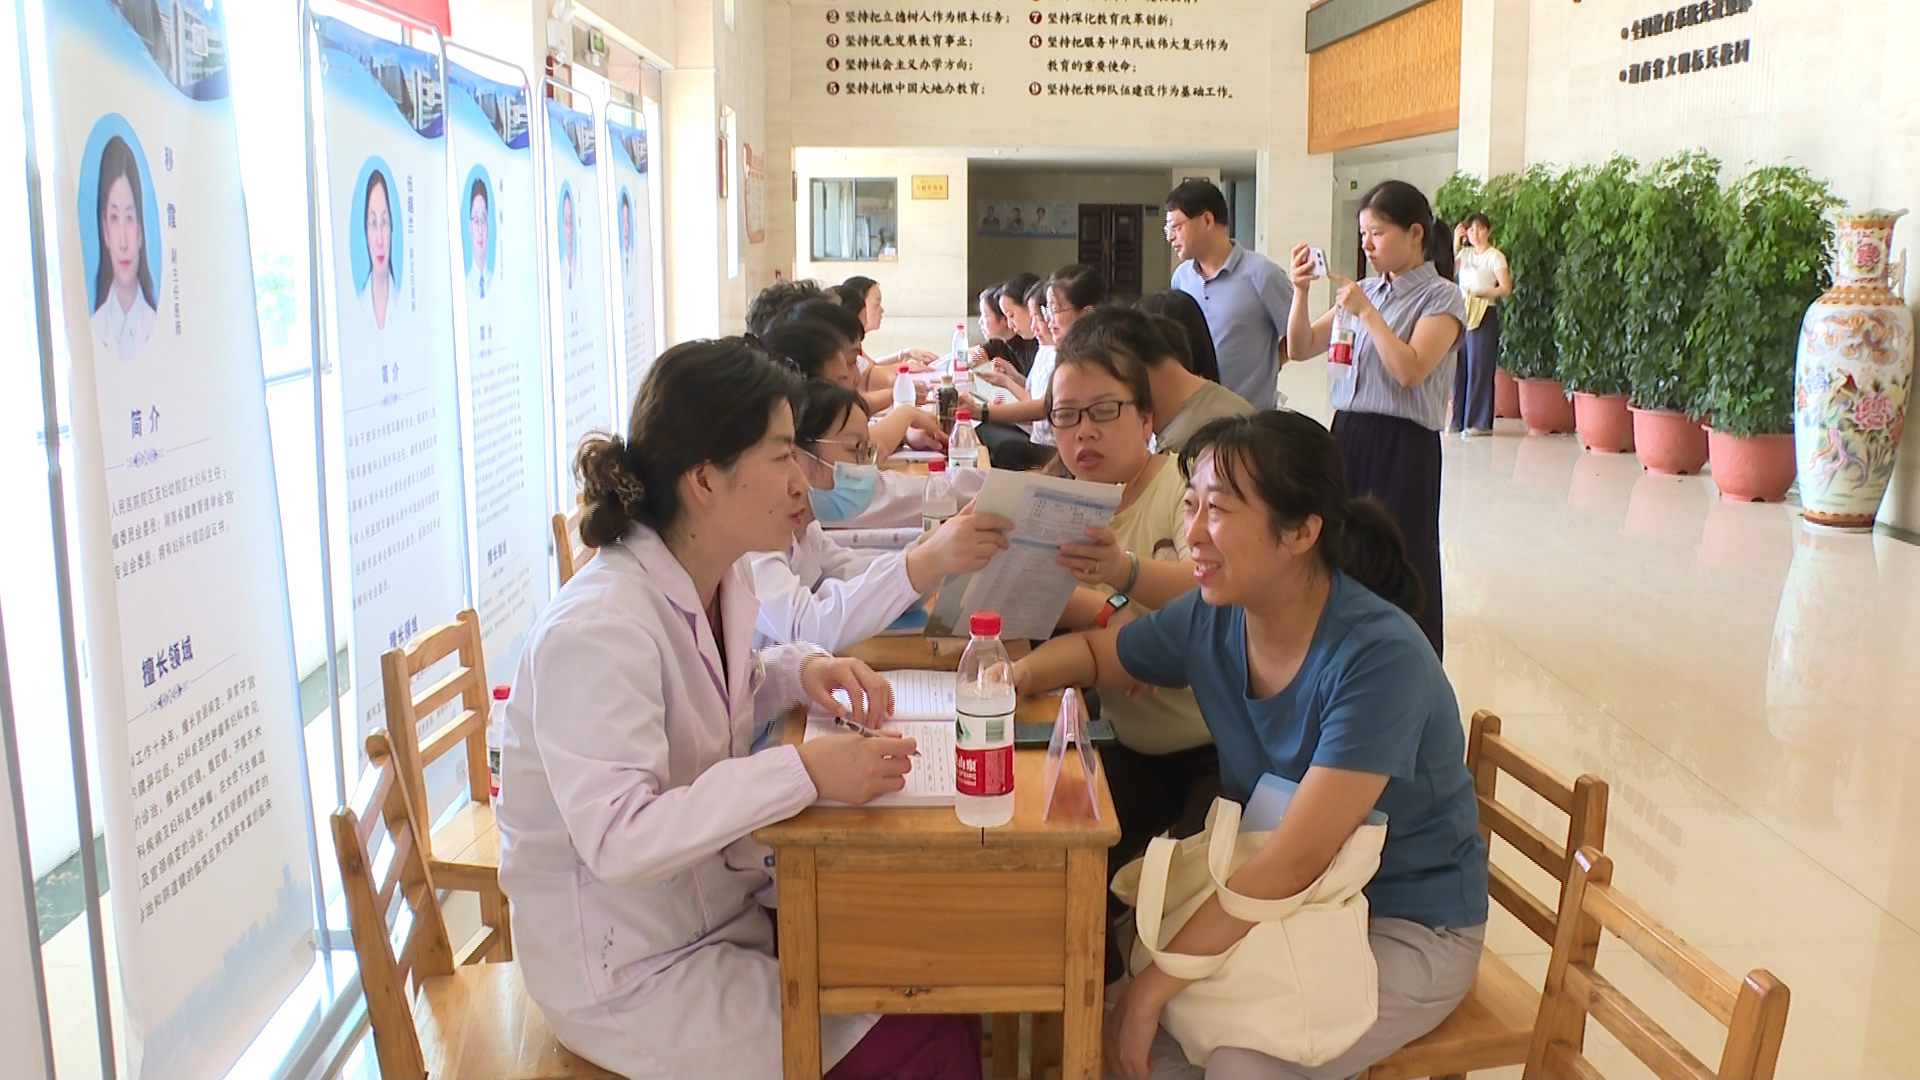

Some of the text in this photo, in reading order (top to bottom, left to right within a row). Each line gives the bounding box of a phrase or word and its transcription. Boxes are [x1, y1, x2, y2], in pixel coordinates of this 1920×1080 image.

[1047, 34, 1229, 51] 坚持把服务中华民族伟大复兴作为
[382, 361, 399, 384] 简介
[131, 405, 160, 438] 简介
[142, 635, 194, 688] 擅长领域
